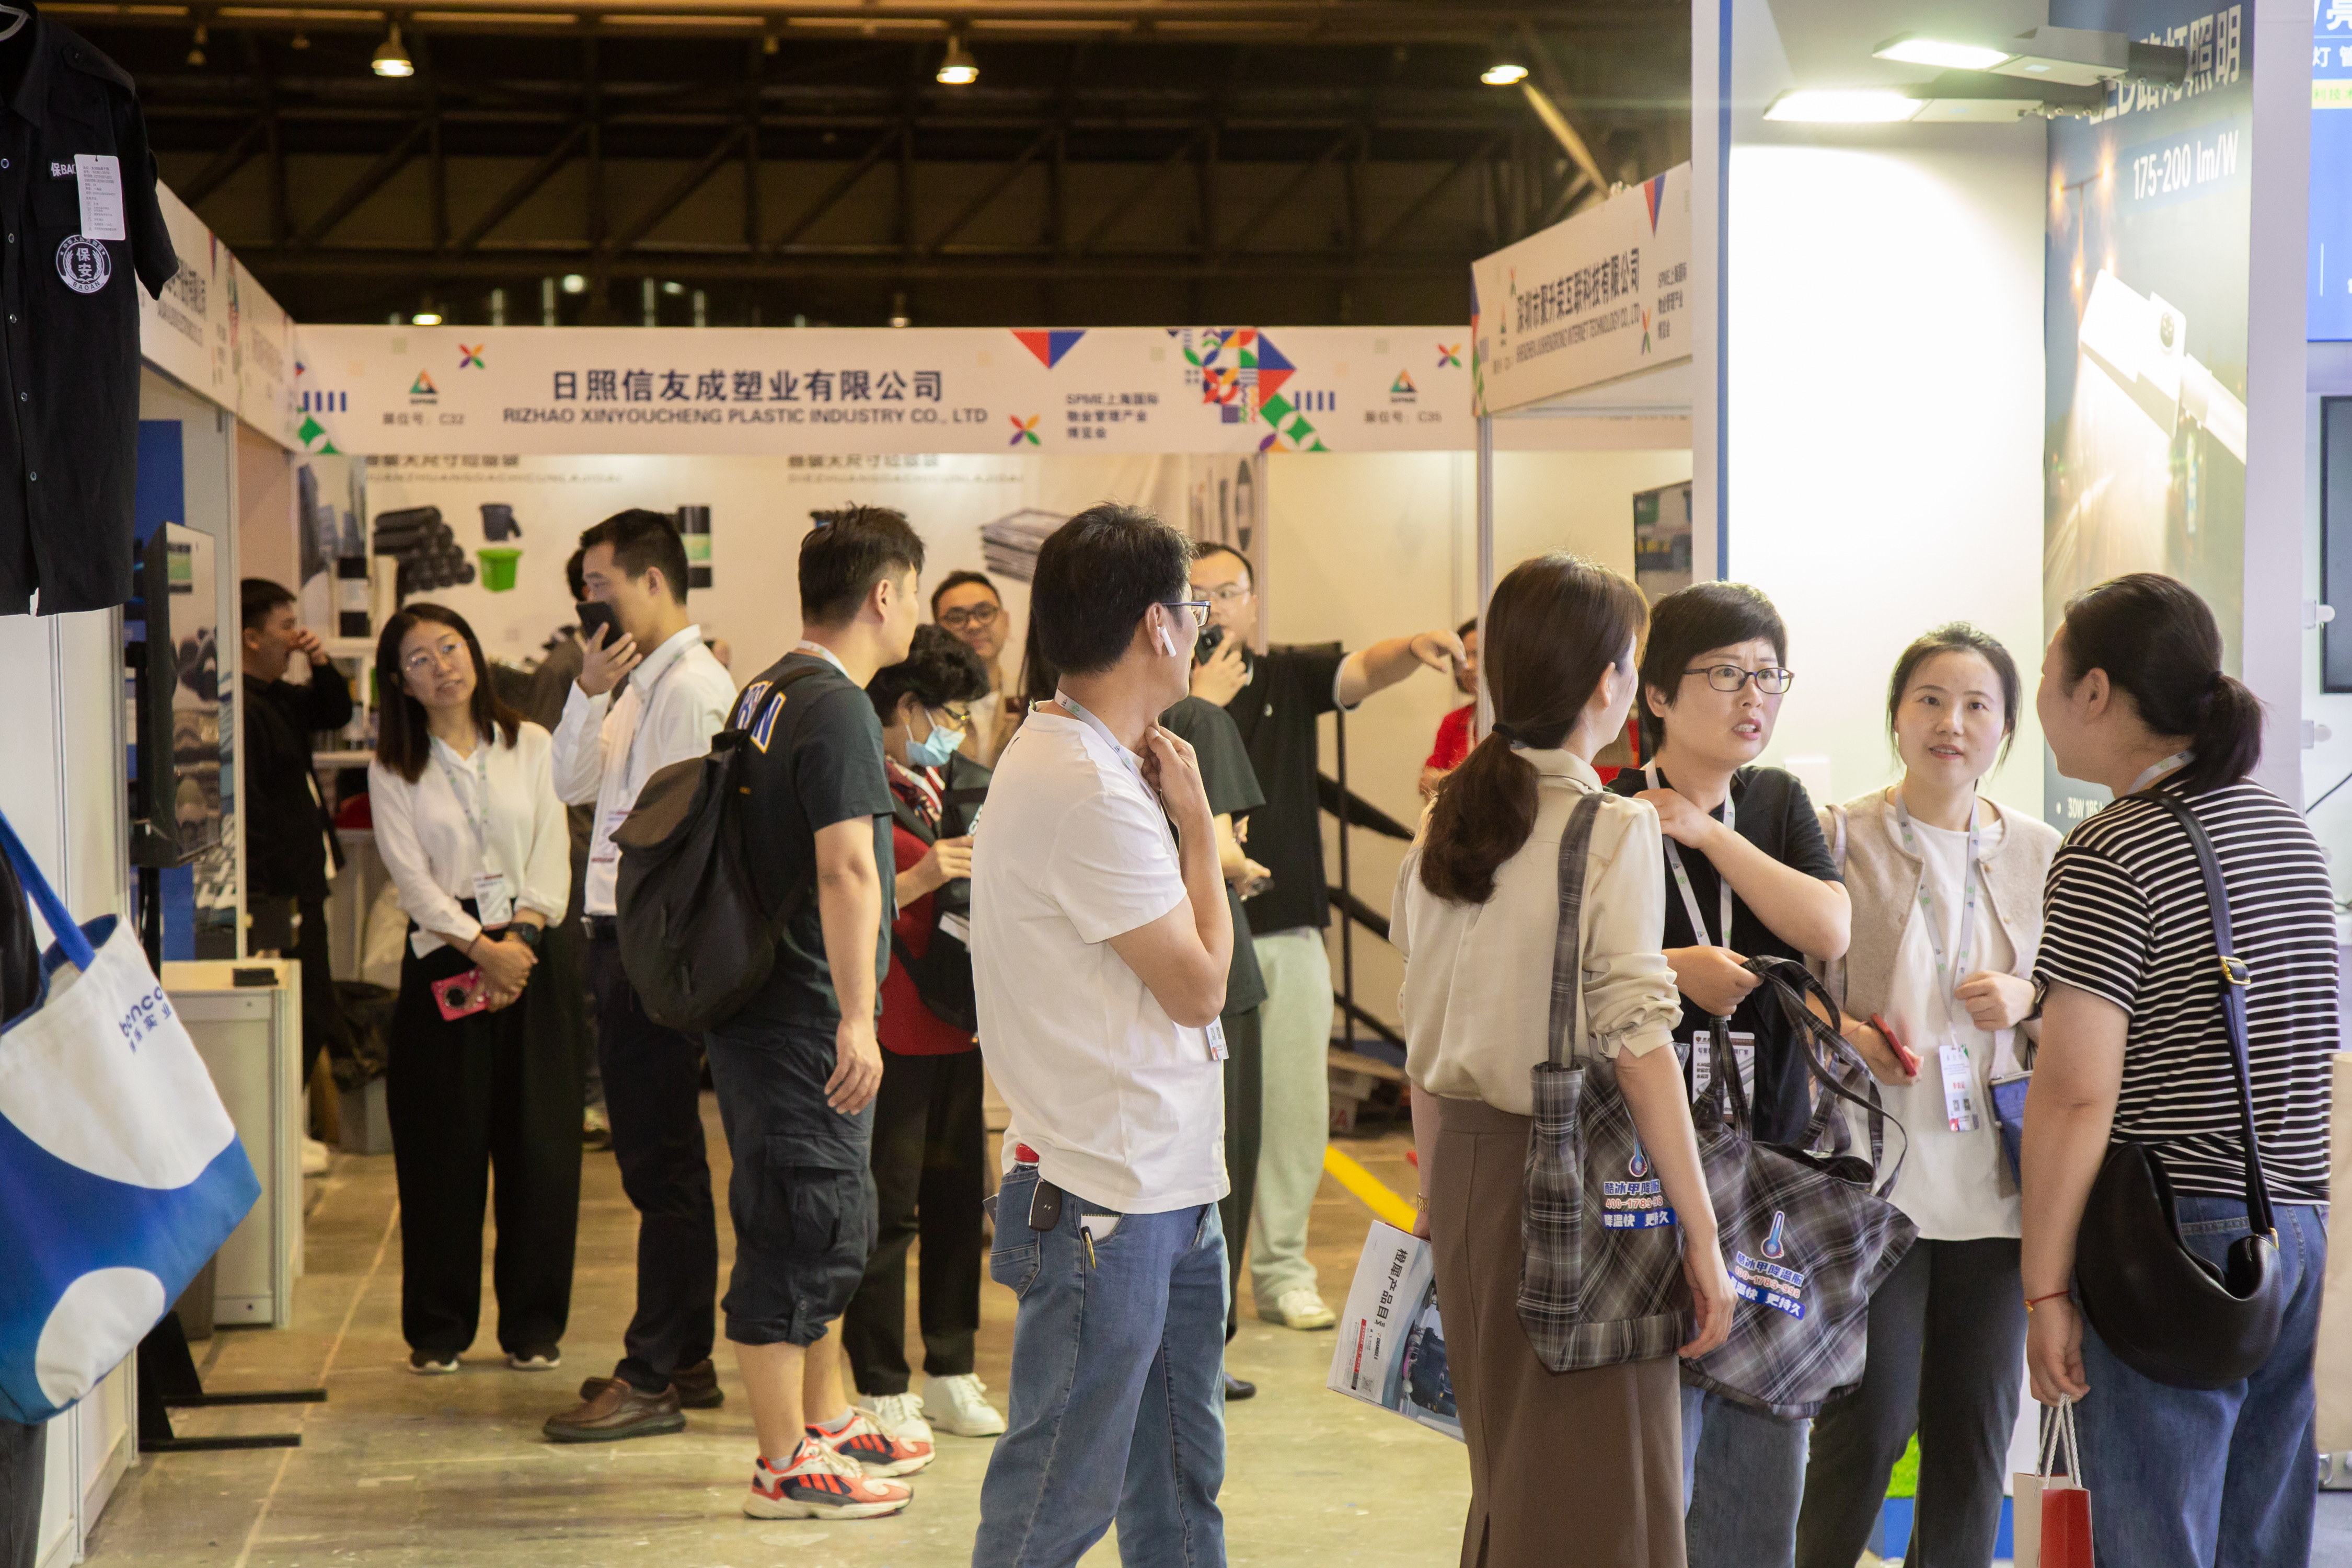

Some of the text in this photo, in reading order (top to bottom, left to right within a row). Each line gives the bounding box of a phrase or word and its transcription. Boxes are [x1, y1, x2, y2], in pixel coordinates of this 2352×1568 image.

[2133, 130, 2239, 200] 175-200 lm/W
[76, 247, 92, 278] 保安
[73, 281, 100, 291] BAOAN
[554, 370, 942, 401] 日照信友成塑业有限公司
[504, 409, 574, 423] RIZHAO
[581, 409, 722, 424] XINYOUCHENG
[729, 409, 804, 424] PLASTIC
[811, 409, 905, 424] INDUSTRY
[953, 409, 987, 424] LTD
[1604, 1214, 1635, 1227] 降温快
[1735, 1265, 1801, 1299] 400-1783-998
[1736, 1250, 1805, 1287] 酷冰甲降温服
[1765, 1293, 1801, 1317] 更持久
